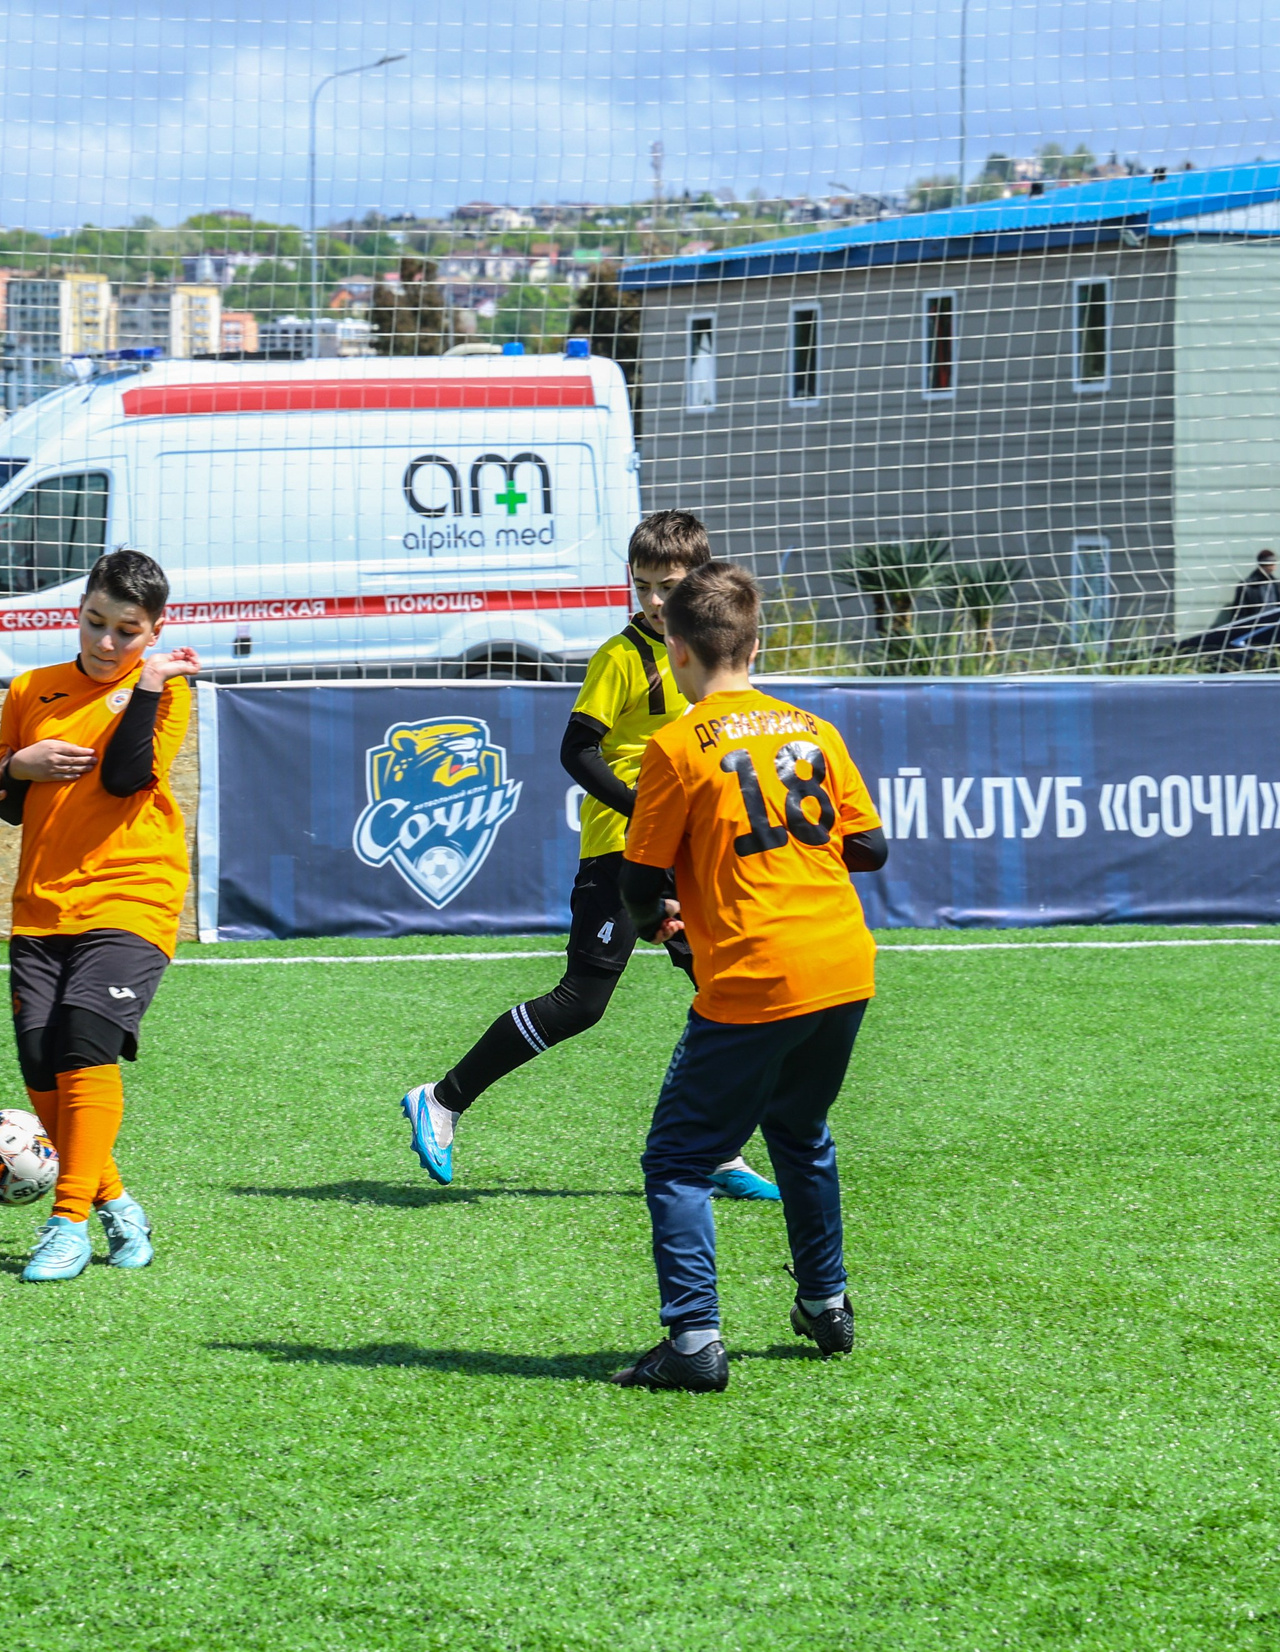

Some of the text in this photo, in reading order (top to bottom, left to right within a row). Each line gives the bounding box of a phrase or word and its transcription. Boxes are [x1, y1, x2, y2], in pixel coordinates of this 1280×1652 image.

[402, 520, 555, 557] alpika med
[2, 594, 484, 629] СКОРА МЕДИЦИНСКАЯ ПОМОЩЬ
[720, 740, 836, 858] 18
[942, 776, 1088, 839] КЛУБ
[1098, 774, 1280, 838] «СОЧИ»
[597, 920, 615, 945] 4
